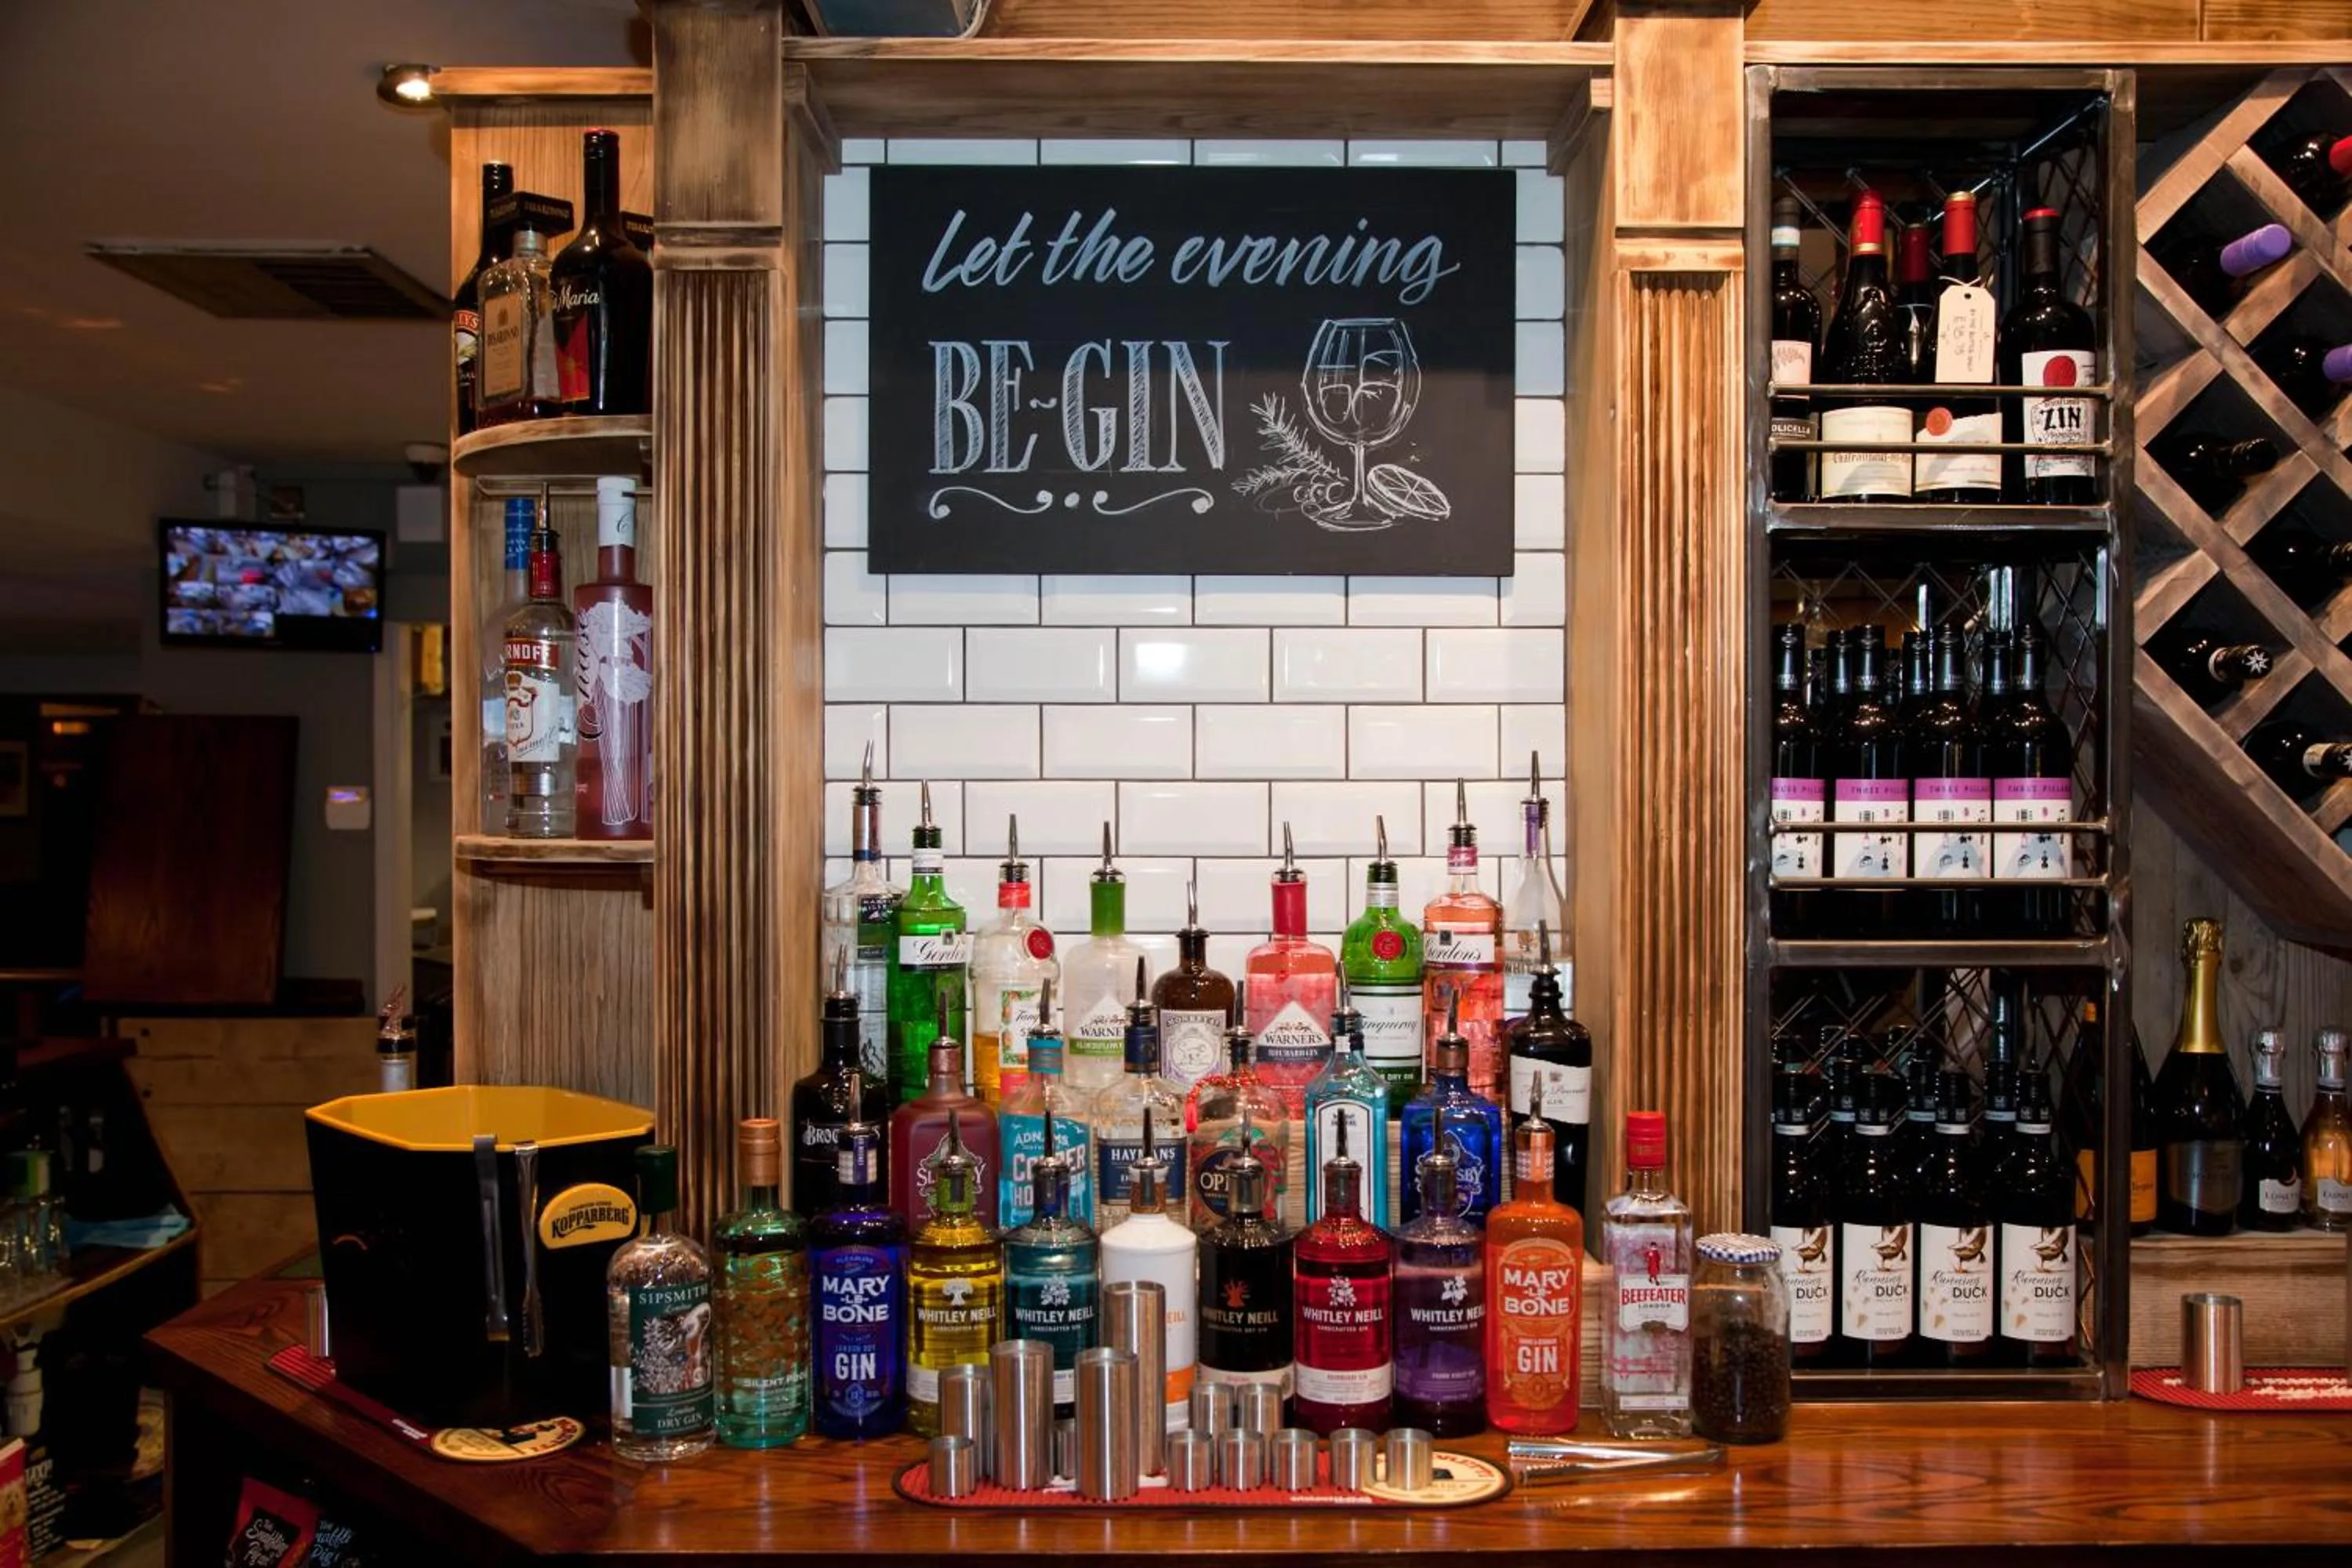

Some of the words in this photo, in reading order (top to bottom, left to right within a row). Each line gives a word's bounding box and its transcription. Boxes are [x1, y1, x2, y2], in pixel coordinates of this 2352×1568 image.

[922, 209, 1034, 292] Let
[1041, 206, 1155, 291] the
[1170, 217, 1461, 305] evening
[557, 284, 600, 312] Maria
[2039, 407, 2082, 430] ZIN
[1771, 423, 1811, 436] OLICELLA
[506, 644, 550, 661] RNOFF
[1080, 1026, 1122, 1037] WARNE
[1014, 1132, 1069, 1147] ADNMS
[1200, 1172, 1229, 1190] OPI
[551, 1201, 630, 1238] KOPPARBERG
[822, 1275, 891, 1297] MARY
[1503, 1269, 1570, 1289] MARY
[638, 1283, 709, 1305] SIPSMITH
[1621, 1288, 1686, 1305] BEEFEATER
[1952, 1287, 1987, 1299] DUCK
[2034, 1287, 2071, 1298] DUCK
[822, 1304, 891, 1323] BONE
[916, 1307, 967, 1323] WHITLEY
[970, 1305, 996, 1322] NEILL
[1014, 1306, 1065, 1323] WHITLEY
[1069, 1305, 1094, 1323] NEILL
[1302, 1307, 1352, 1324] WHITLEY
[1354, 1308, 1384, 1323] NEILL
[1410, 1308, 1464, 1323] WHITLEY
[1504, 1298, 1570, 1316] BONE
[1247, 1310, 1279, 1324] NEILL
[835, 1353, 877, 1380] GIN
[1517, 1345, 1558, 1373] GIN
[657, 1416, 681, 1428] DRY
[683, 1413, 702, 1426] GIN
